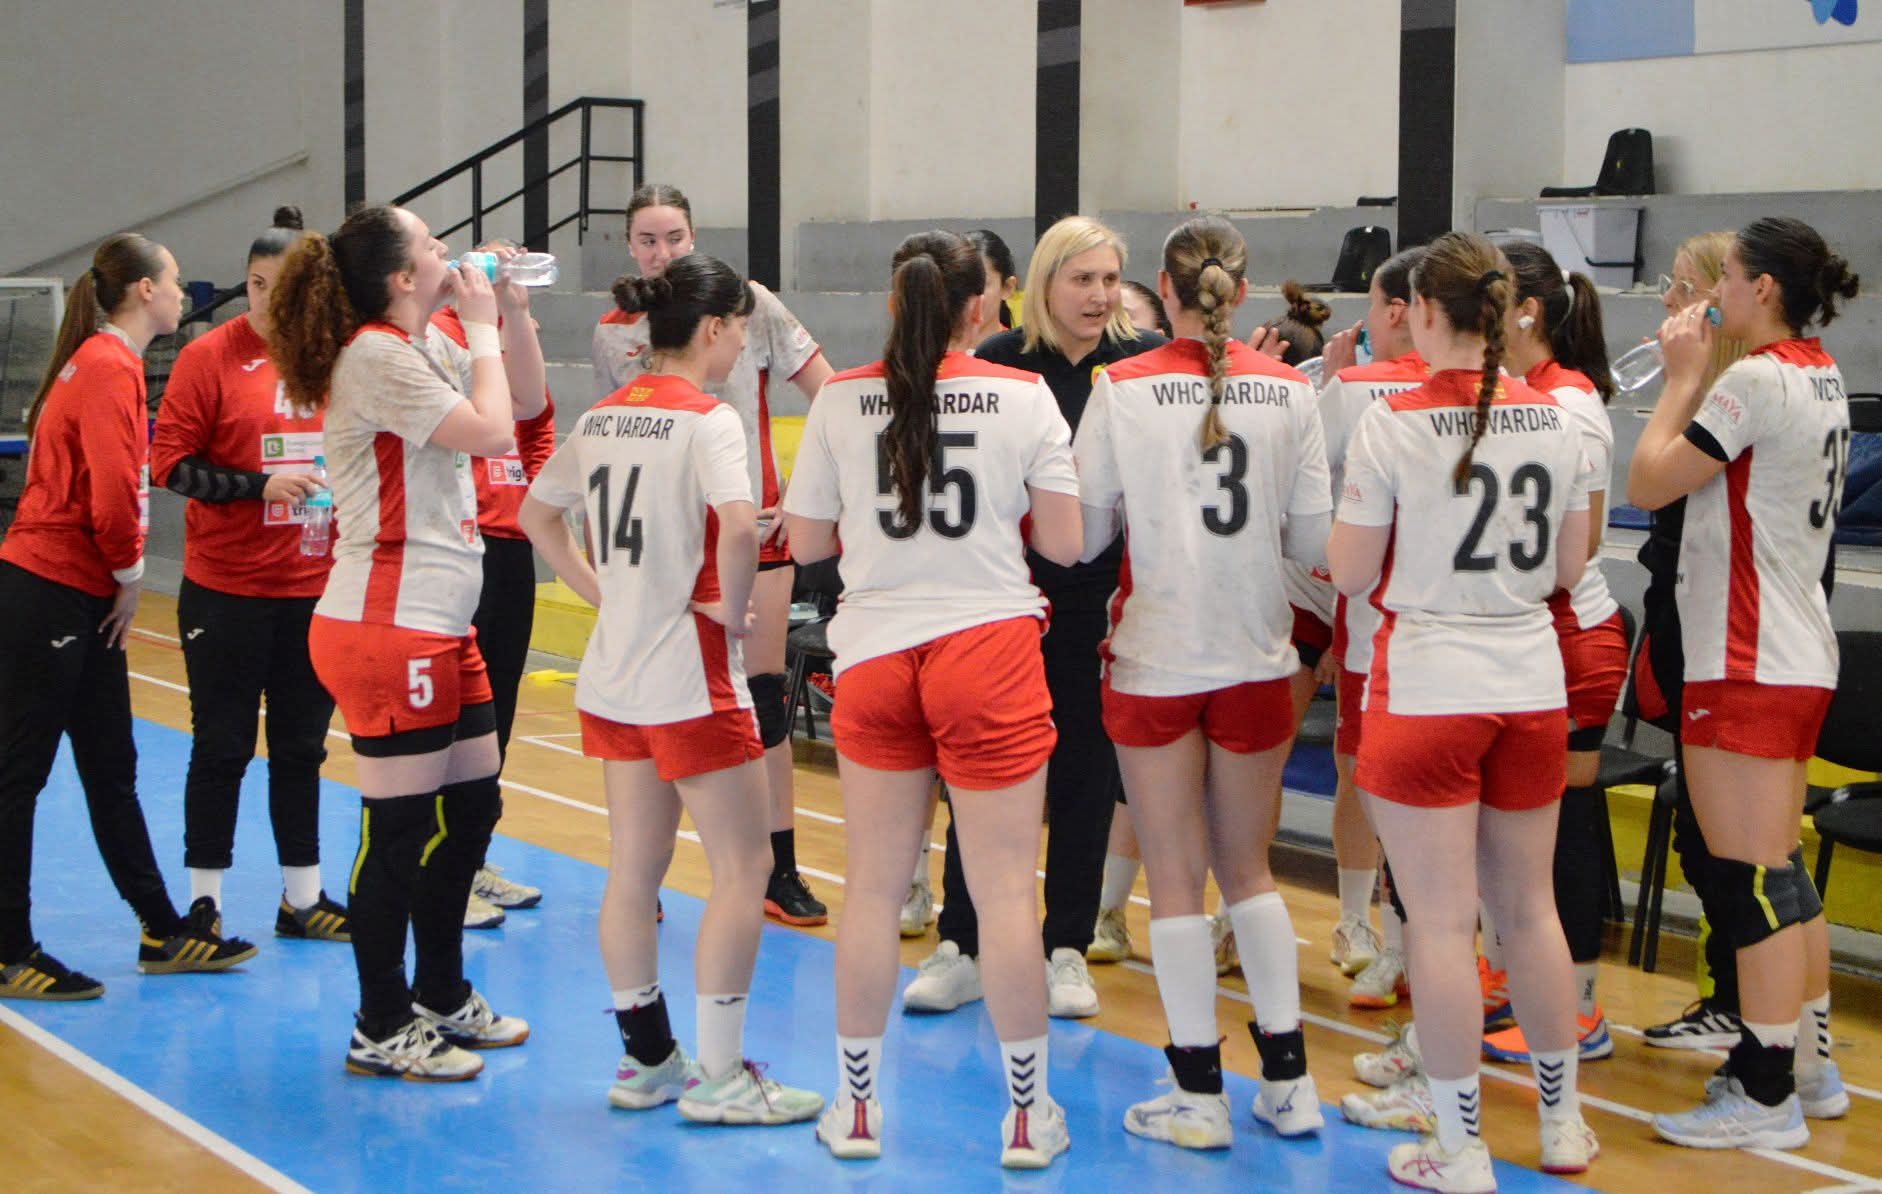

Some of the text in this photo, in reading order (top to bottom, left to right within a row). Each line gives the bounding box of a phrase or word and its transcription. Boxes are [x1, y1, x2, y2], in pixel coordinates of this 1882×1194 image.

[582, 415, 675, 441] WHC VARDAR
[860, 392, 1000, 416] WH ARDAR
[1152, 381, 1289, 408] WHC ARDAR
[1488, 407, 1563, 435] VARDAR
[588, 464, 644, 567] 14
[875, 431, 978, 541] 55
[1200, 431, 1249, 538] 3
[1809, 427, 1849, 528] 3
[1452, 462, 1552, 573] 23
[407, 658, 434, 709] 5
